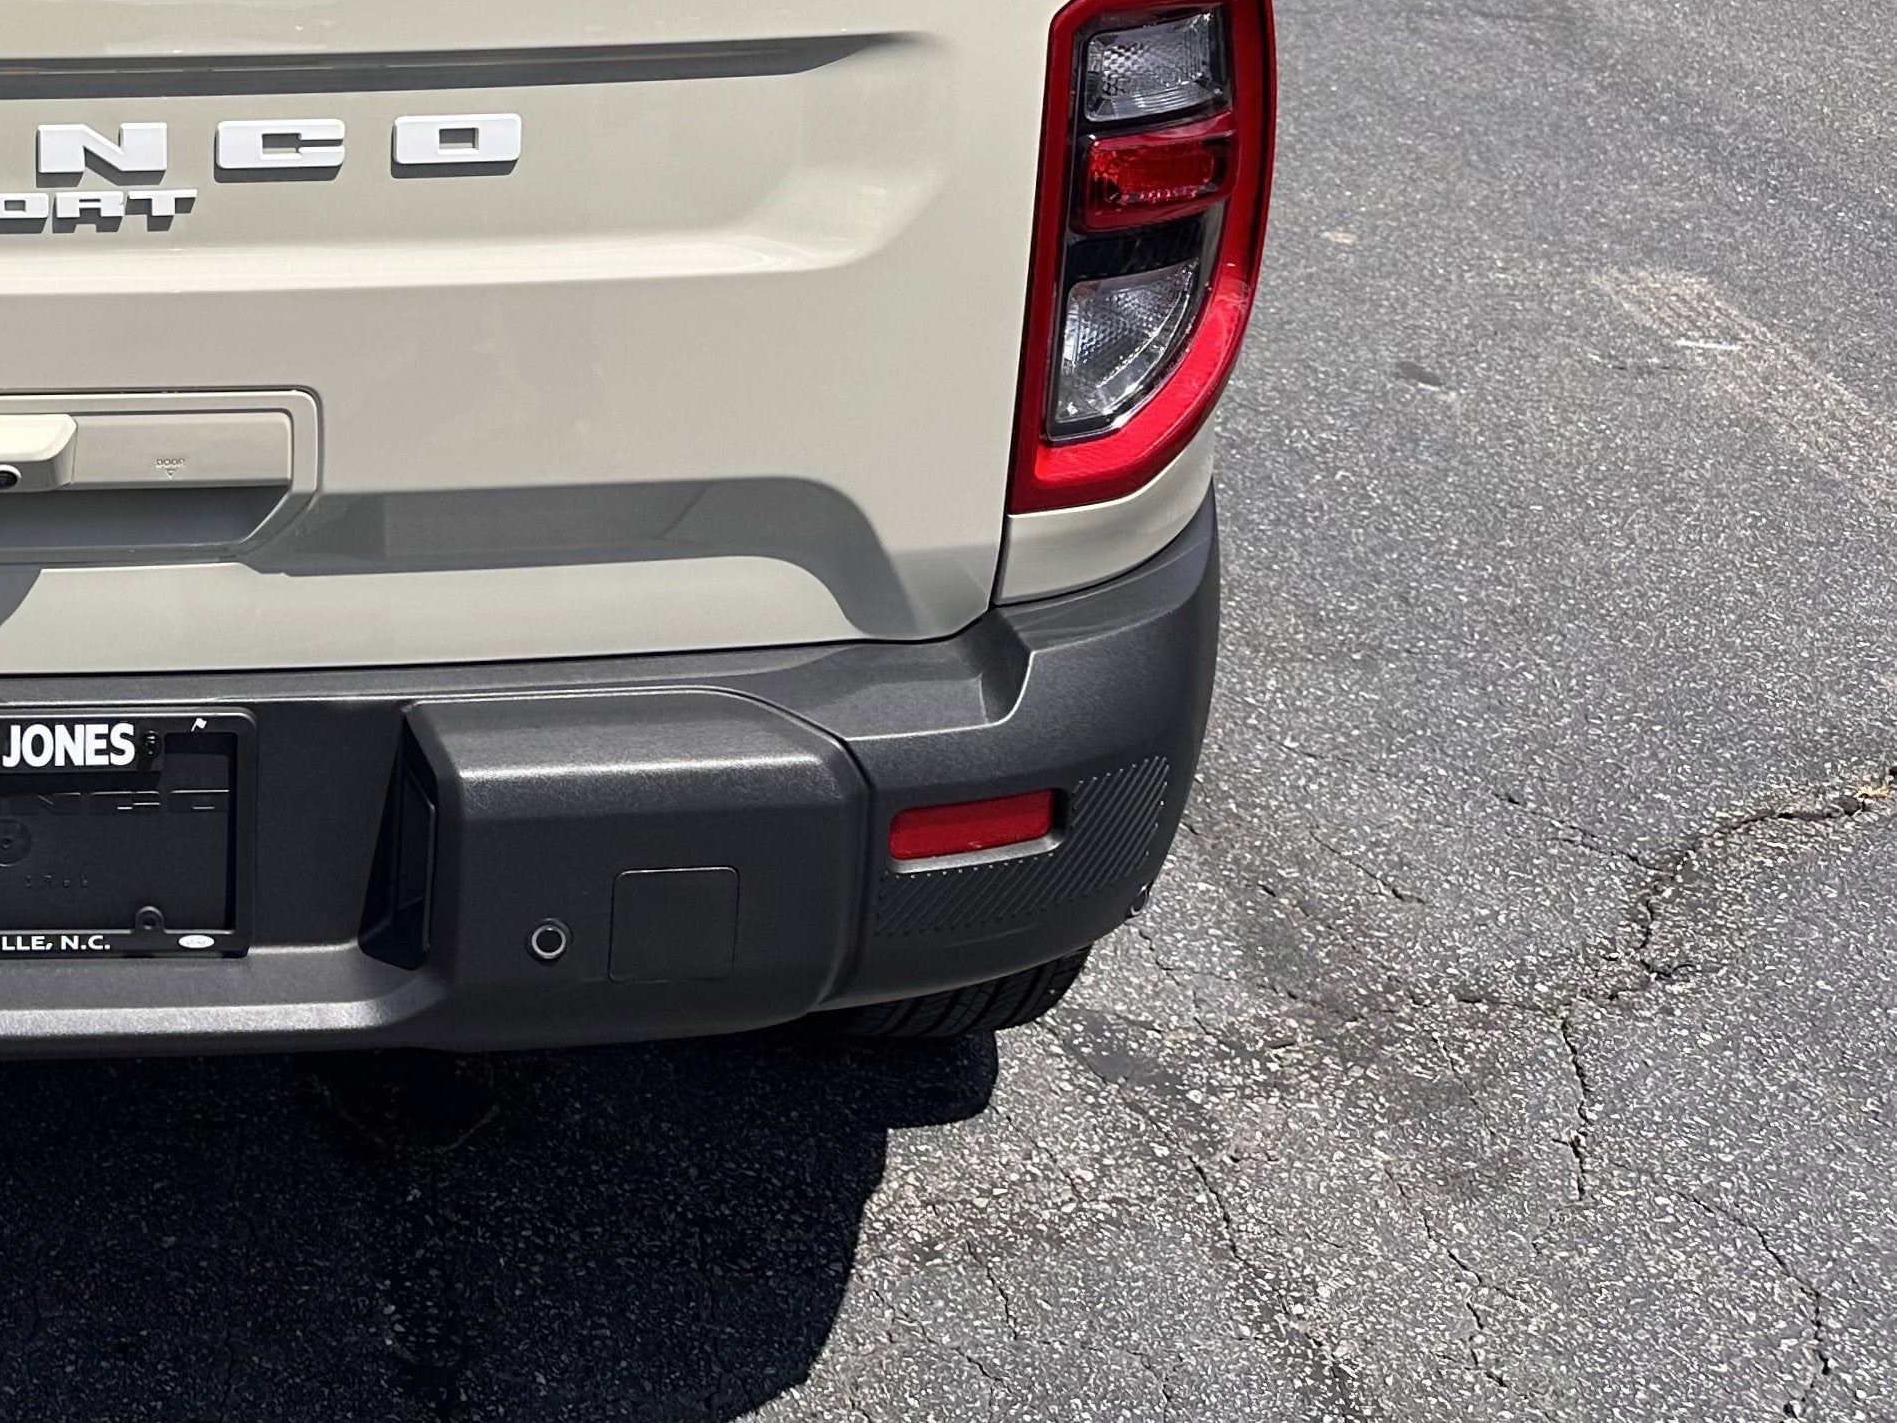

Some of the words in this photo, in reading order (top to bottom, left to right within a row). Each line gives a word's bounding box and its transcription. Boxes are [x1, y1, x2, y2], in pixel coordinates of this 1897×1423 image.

[155, 457, 187, 469] DOOR
[2, 722, 136, 767] JONES
[60, 934, 112, 951] N.C.
